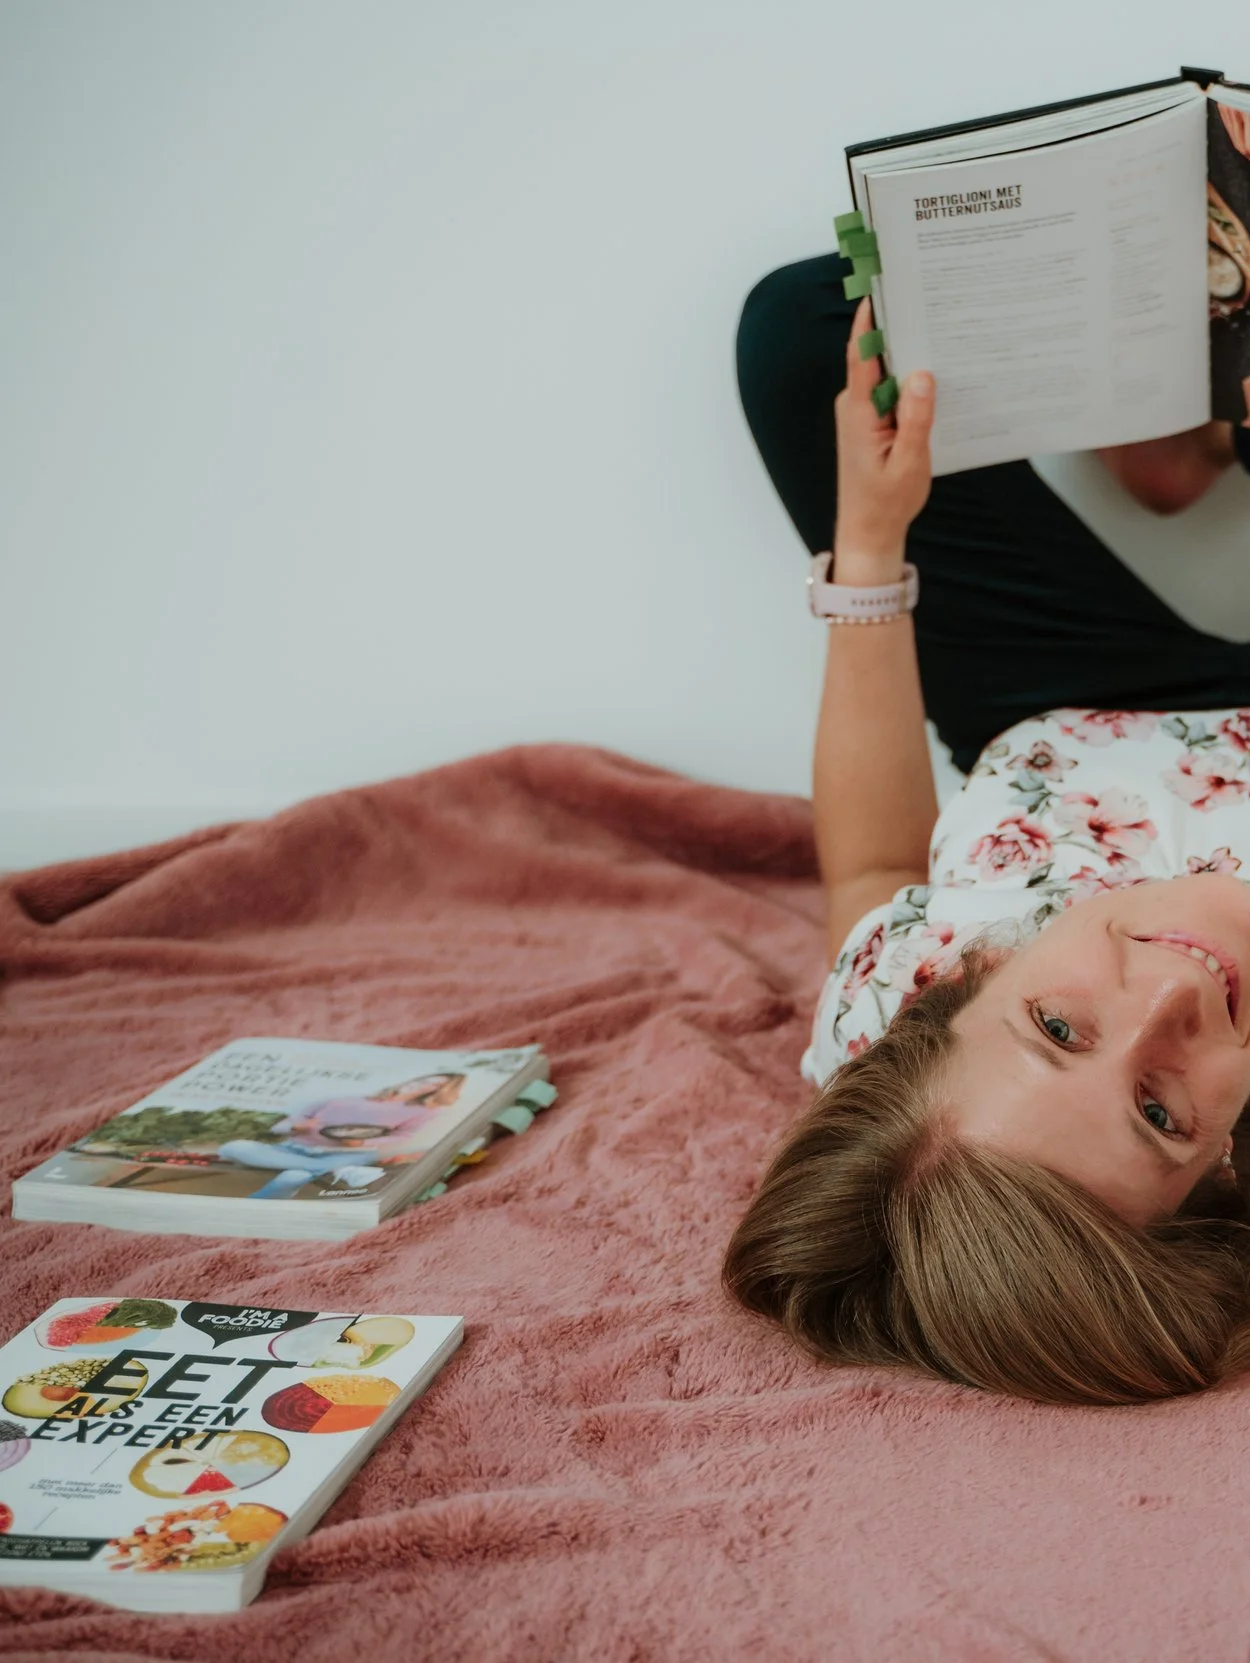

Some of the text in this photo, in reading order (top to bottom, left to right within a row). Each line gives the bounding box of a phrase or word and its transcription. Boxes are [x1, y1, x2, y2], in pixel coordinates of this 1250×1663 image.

[914, 185, 1022, 209] TORTIGLIONI MET
[915, 198, 1022, 221] BUTTERNUTSAUS
[198, 1314, 284, 1329] FOODIE
[238, 1309, 289, 1322] I'M A
[213, 1324, 254, 1332] PRESENTS
[79, 1349, 298, 1404] EET
[54, 1395, 250, 1426] ALS EEN
[28, 1415, 231, 1451] EXPERT
